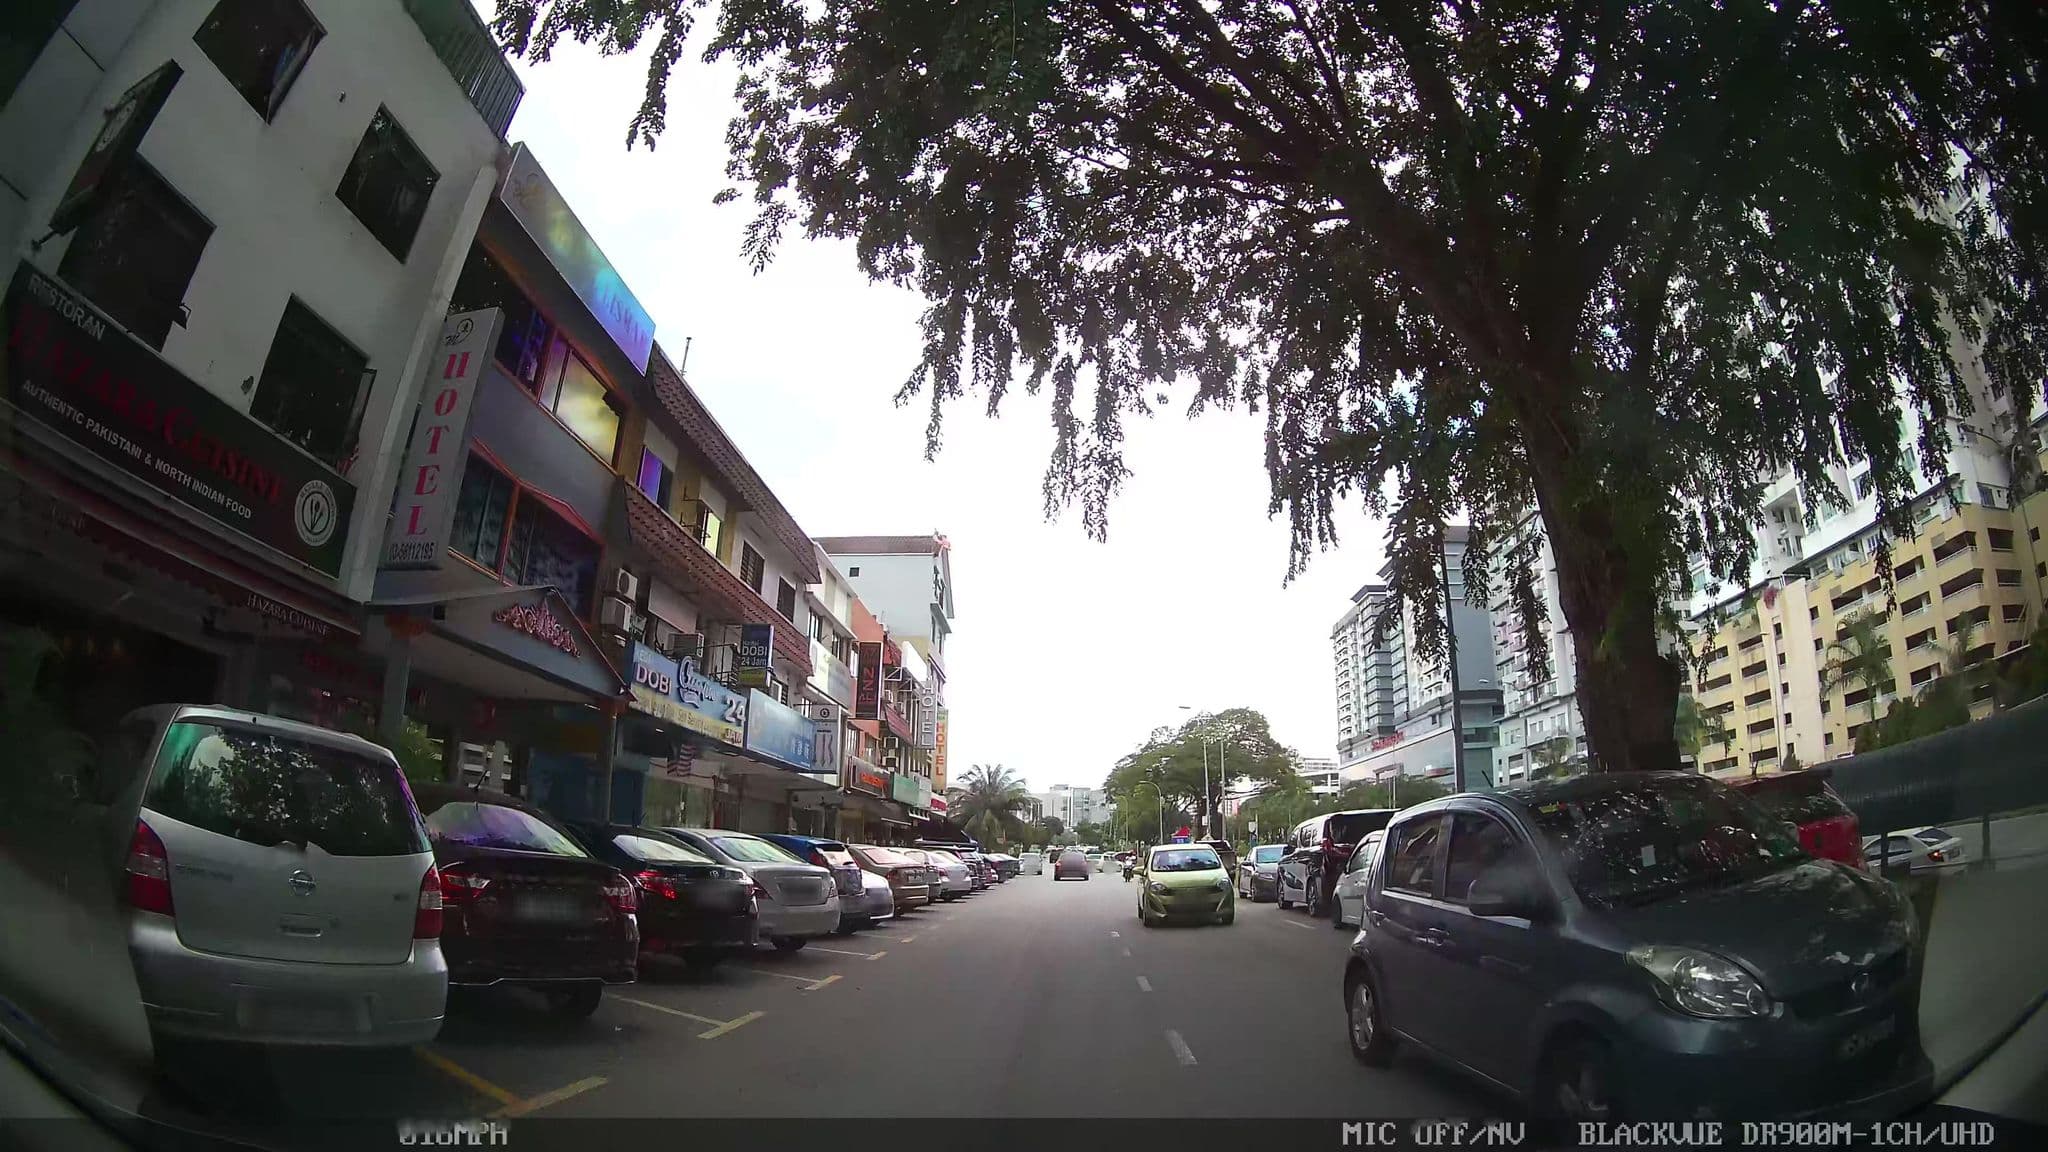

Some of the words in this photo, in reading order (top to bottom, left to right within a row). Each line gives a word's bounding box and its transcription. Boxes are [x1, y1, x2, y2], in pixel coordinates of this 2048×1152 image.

[29, 274, 106, 343] RESTORAN
[22, 379, 85, 425] AUTHENTIC
[86, 417, 142, 461] PAKISTANI
[144, 451, 153, 465] &
[155, 458, 192, 487] NORTH
[192, 480, 225, 506] INDIAN
[225, 494, 252, 520] FOOD
[406, 351, 472, 536] HOTEL
[741, 646, 768, 656] DOBI
[741, 656, 750, 666] 24
[635, 663, 672, 696] DOBI
[724, 696, 746, 723] 24
[921, 682, 935, 747] HOTEL
[935, 722, 946, 776] HOTEL
